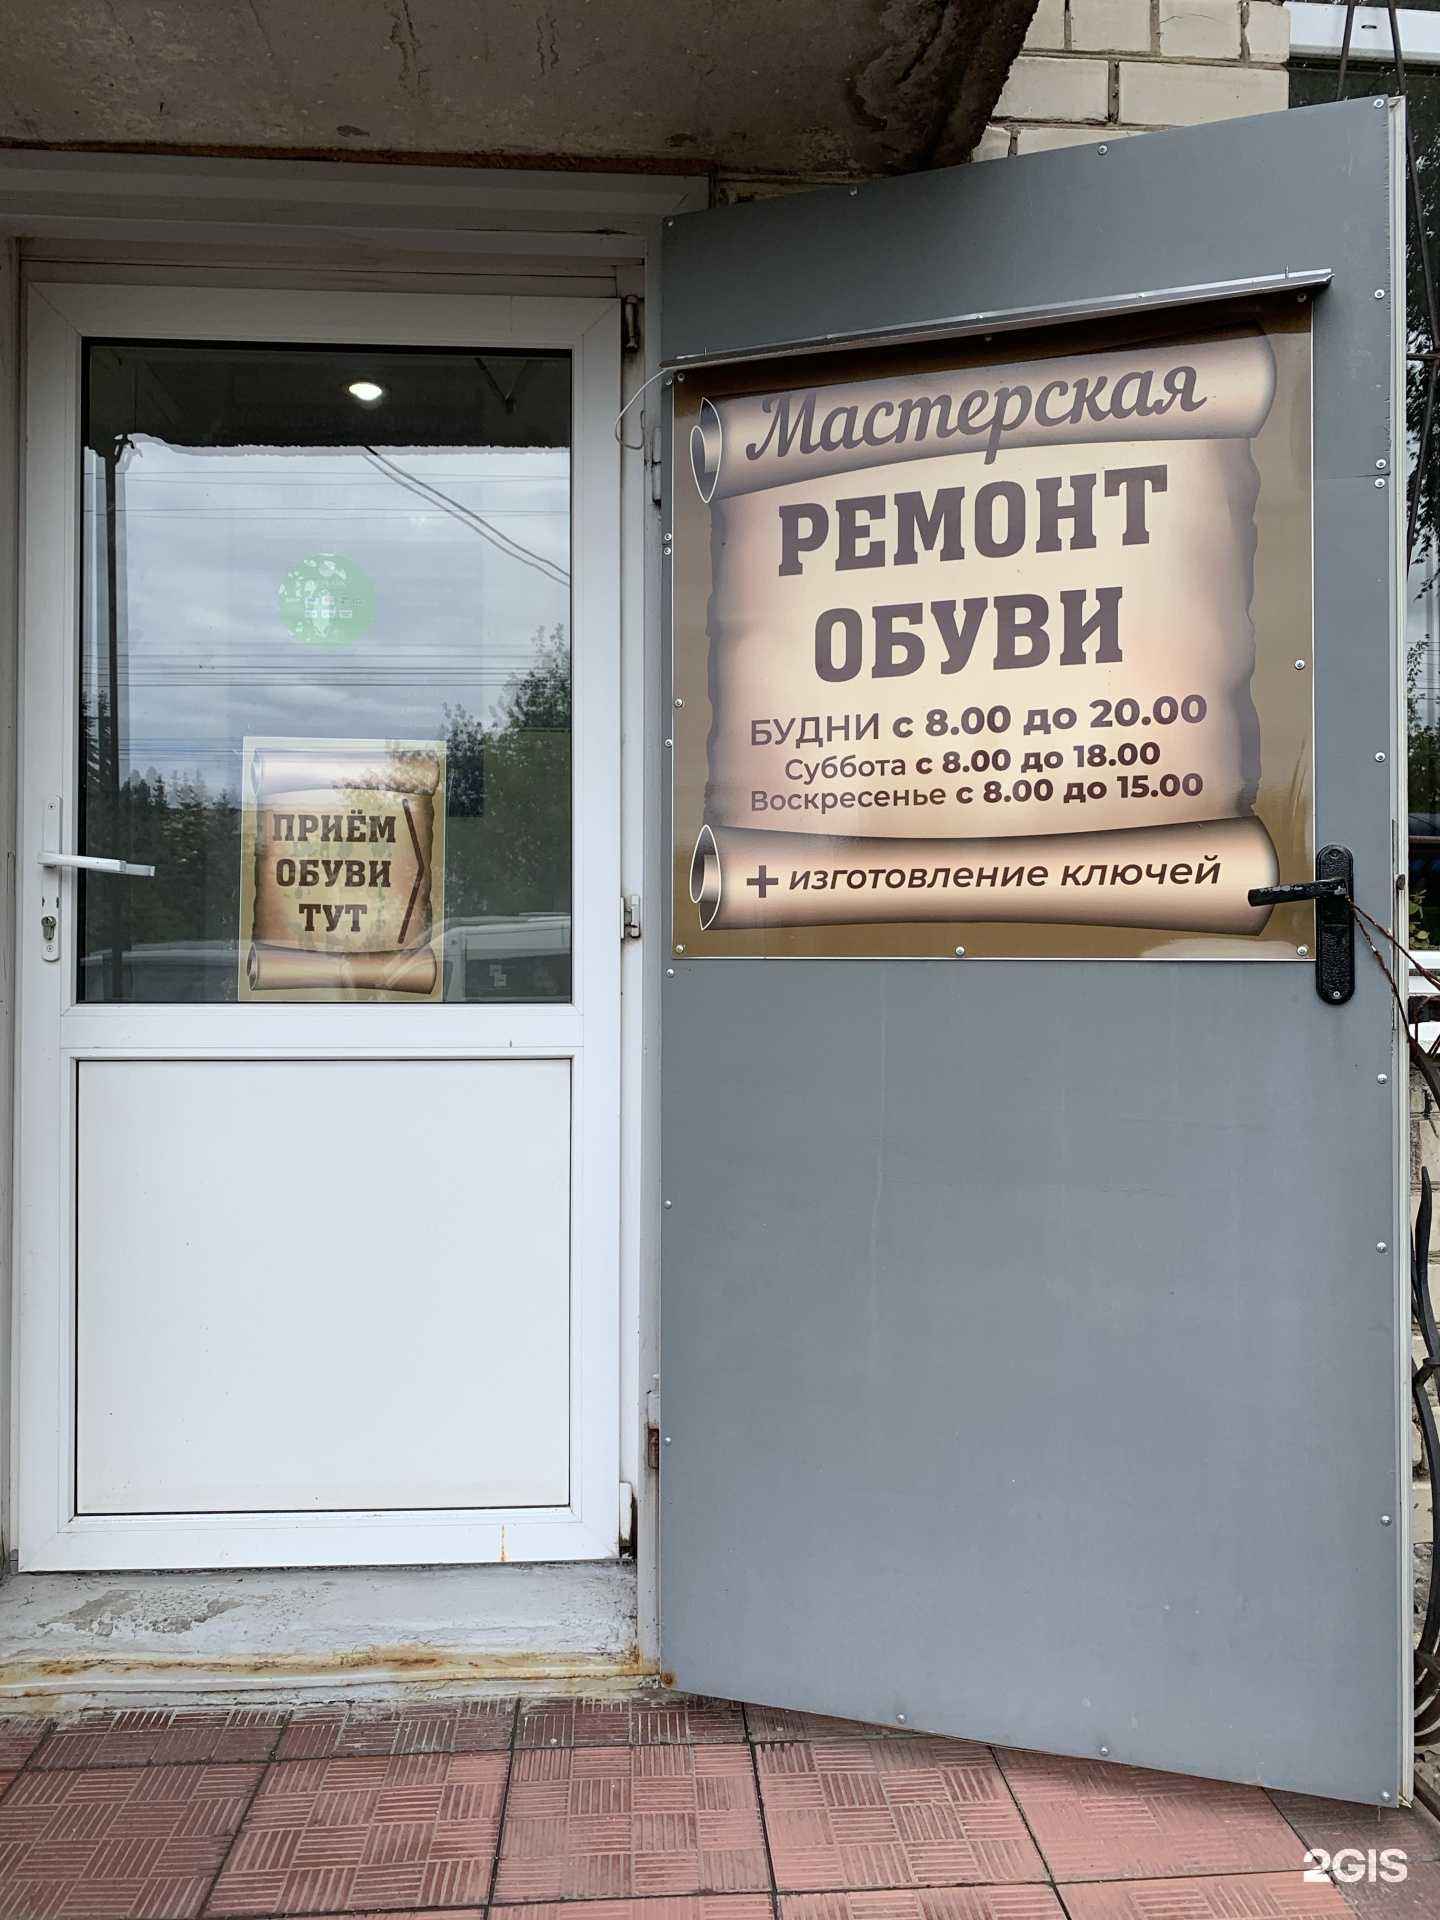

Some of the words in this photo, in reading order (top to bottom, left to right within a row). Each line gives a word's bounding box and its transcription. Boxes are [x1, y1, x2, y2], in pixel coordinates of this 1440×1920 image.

[746, 364, 1207, 464] Мастерская
[778, 464, 1168, 577] РЕМОНТ
[814, 586, 1123, 683] ОБУВИ
[750, 711, 880, 748] БУДНИ
[892, 713, 914, 739] с
[925, 704, 1012, 736] 8.00
[1023, 702, 1077, 735] до
[1090, 694, 1208, 728] 20.00
[785, 754, 906, 783] Суббота
[916, 753, 933, 776] с
[942, 748, 1011, 774] 8.00
[1021, 746, 1064, 774] до
[1073, 741, 1161, 768] 18.00
[750, 784, 946, 814] Воскресенье
[956, 784, 974, 804] с
[983, 779, 1054, 803] 8.00
[1063, 776, 1107, 804] до
[1117, 772, 1204, 799] 15.00
[272, 809, 396, 843] ПРИЁМ
[275, 858, 391, 887] ОБУВИ
[788, 860, 1049, 891] изготовление
[1060, 855, 1221, 887] ключей
[298, 904, 367, 932] ТУТ
